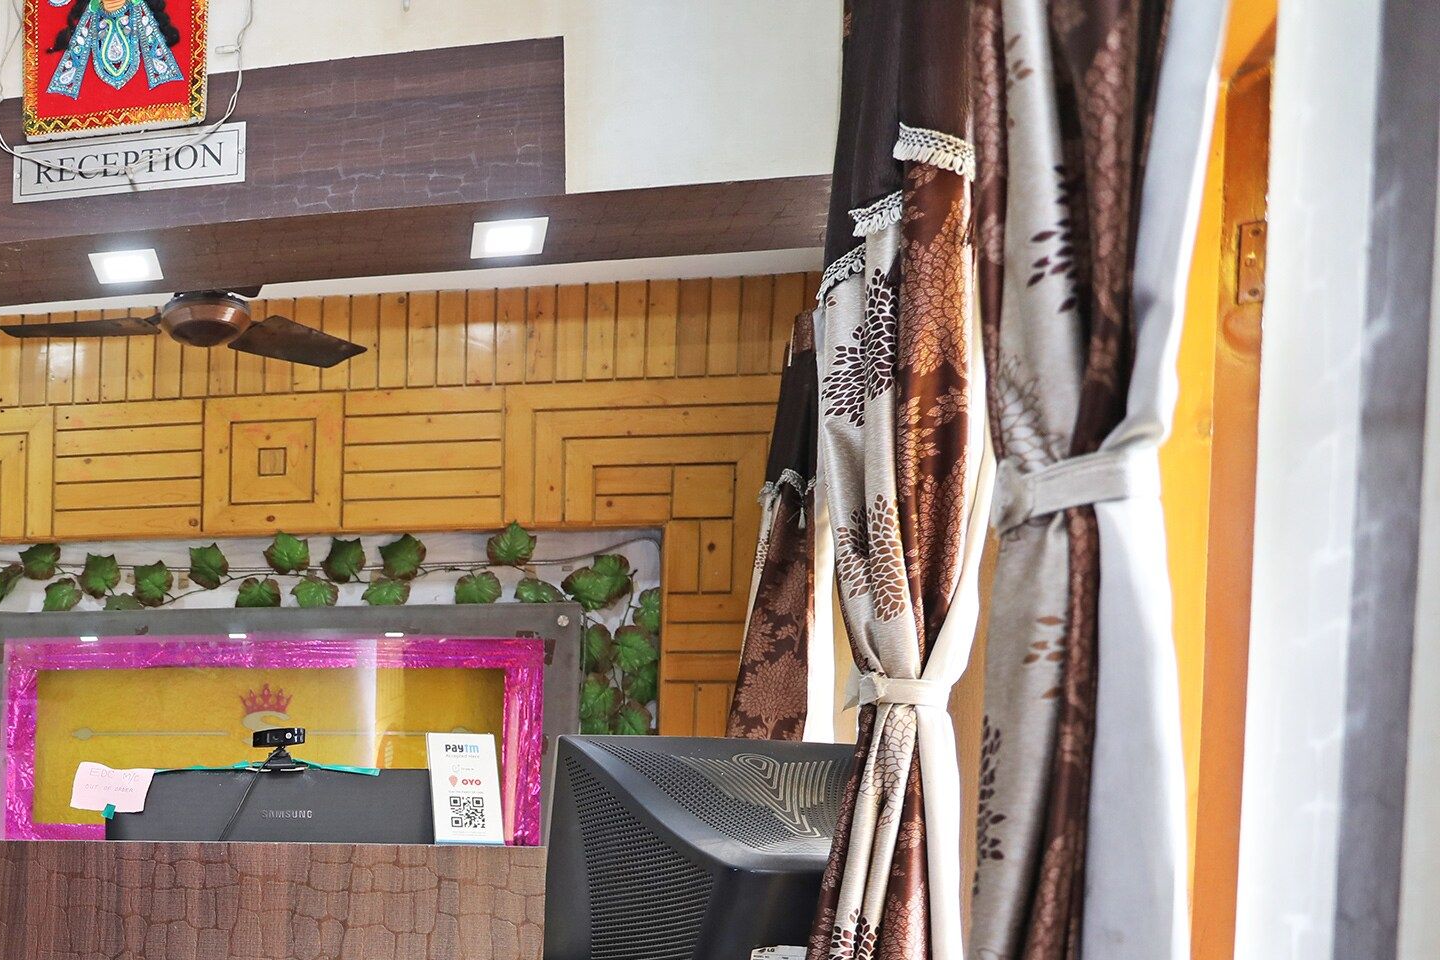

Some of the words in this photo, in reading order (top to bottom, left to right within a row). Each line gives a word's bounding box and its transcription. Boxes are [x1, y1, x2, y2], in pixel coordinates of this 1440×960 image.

[36, 142, 224, 185] RECEPTION
[84, 783, 98, 791] OUT
[262, 809, 313, 819] SAMSUNG
